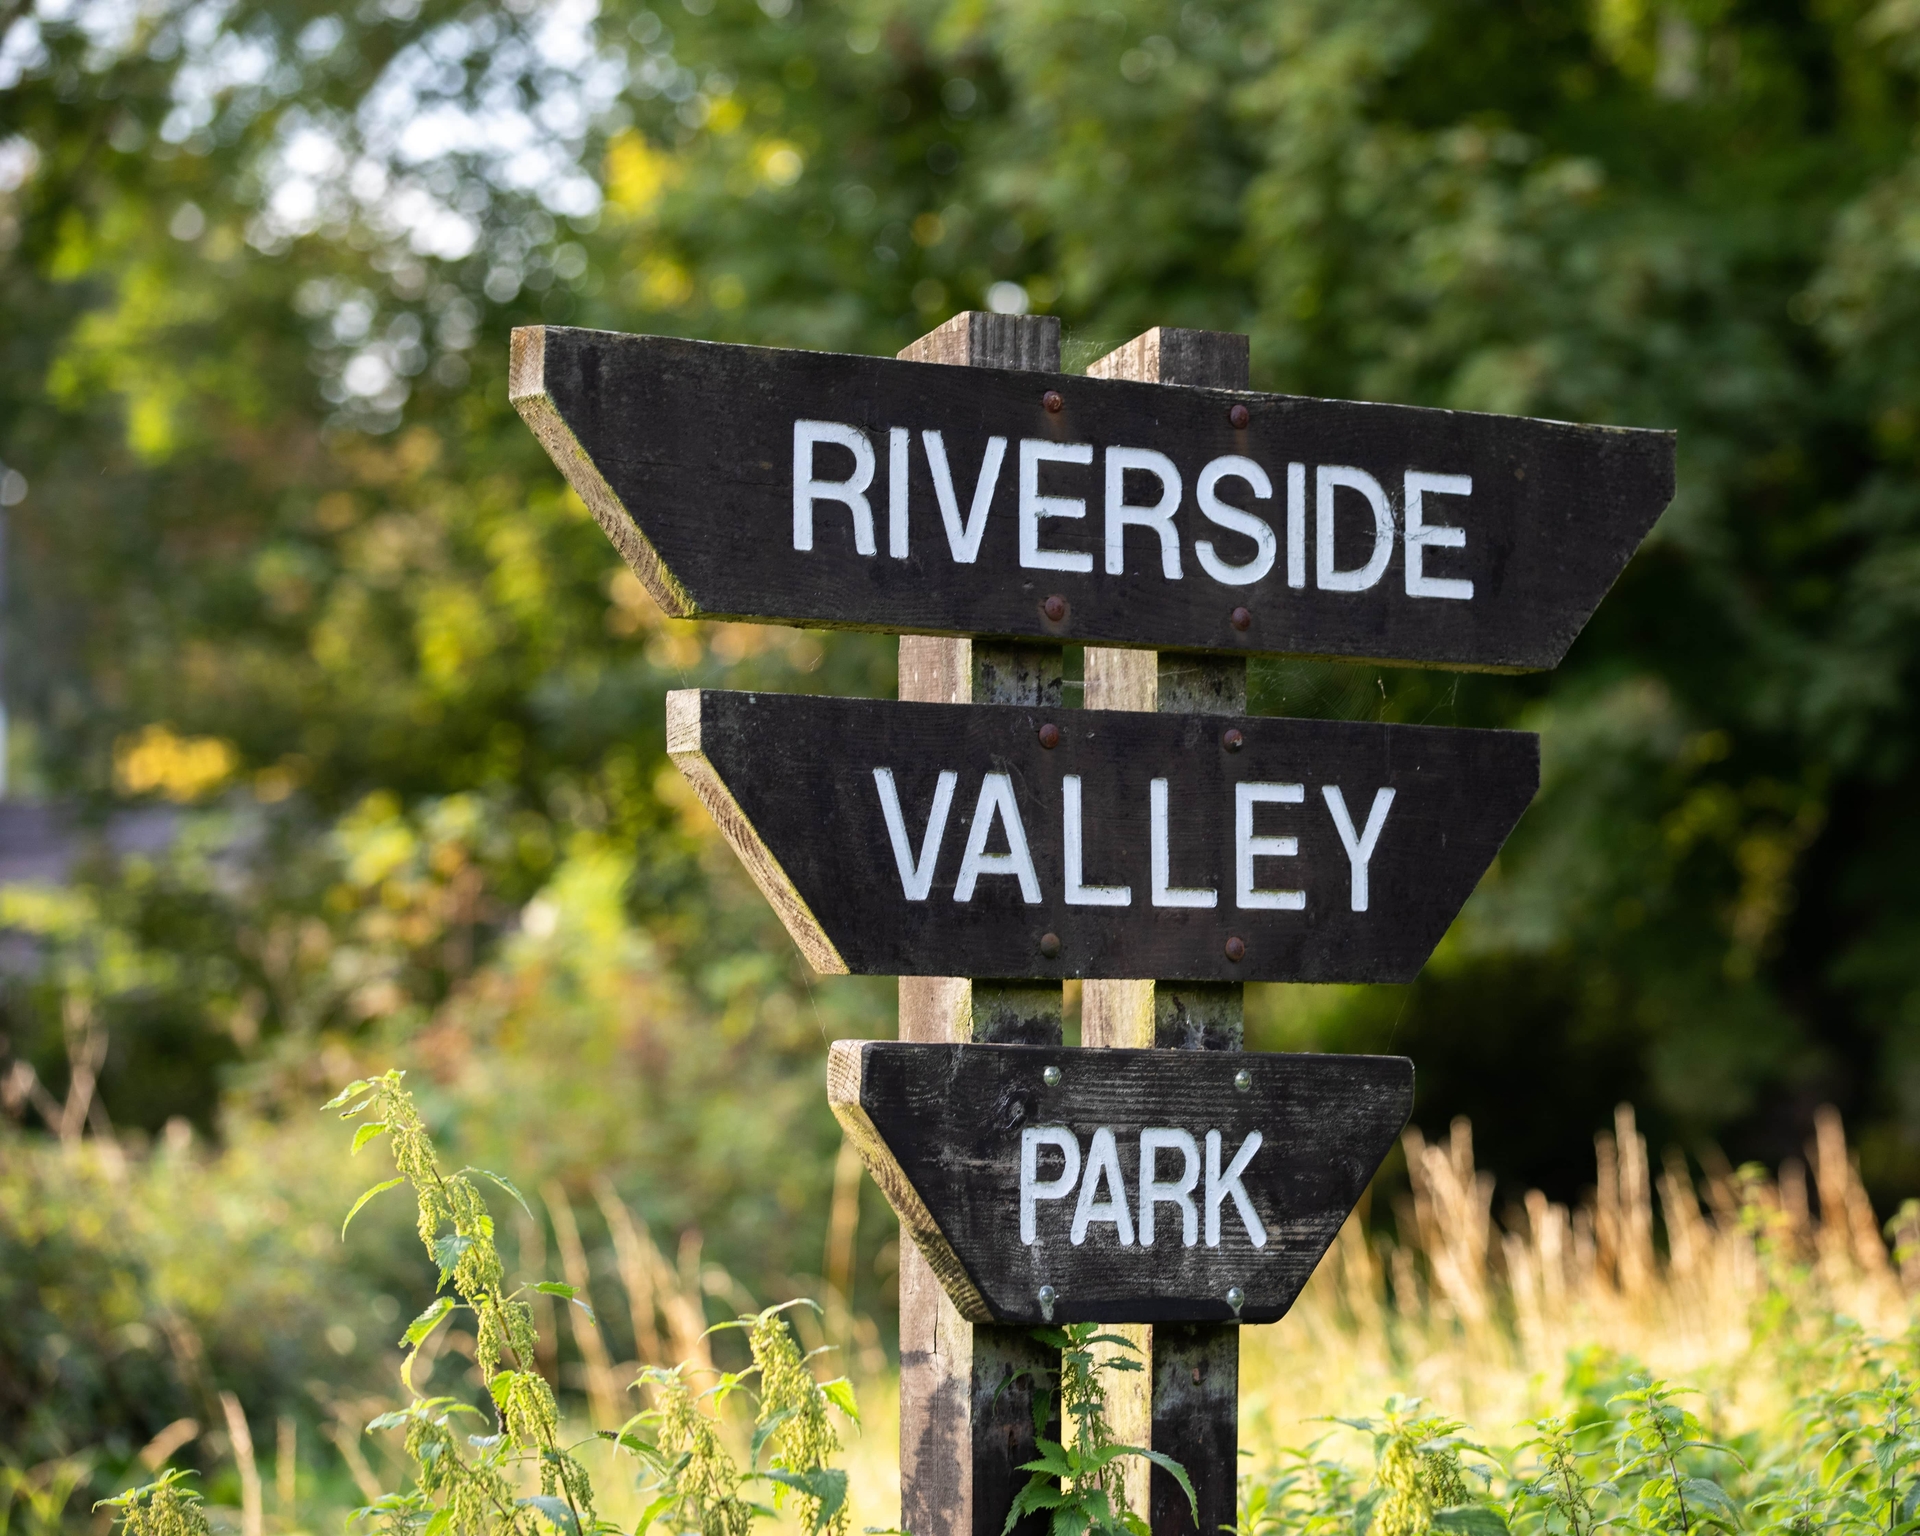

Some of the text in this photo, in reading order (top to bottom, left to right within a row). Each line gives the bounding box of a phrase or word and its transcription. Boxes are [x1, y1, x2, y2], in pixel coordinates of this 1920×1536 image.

[792, 419, 1475, 601] RIVERSIDE
[872, 767, 1397, 914] VALLEY
[1019, 1124, 1268, 1251] PARK
